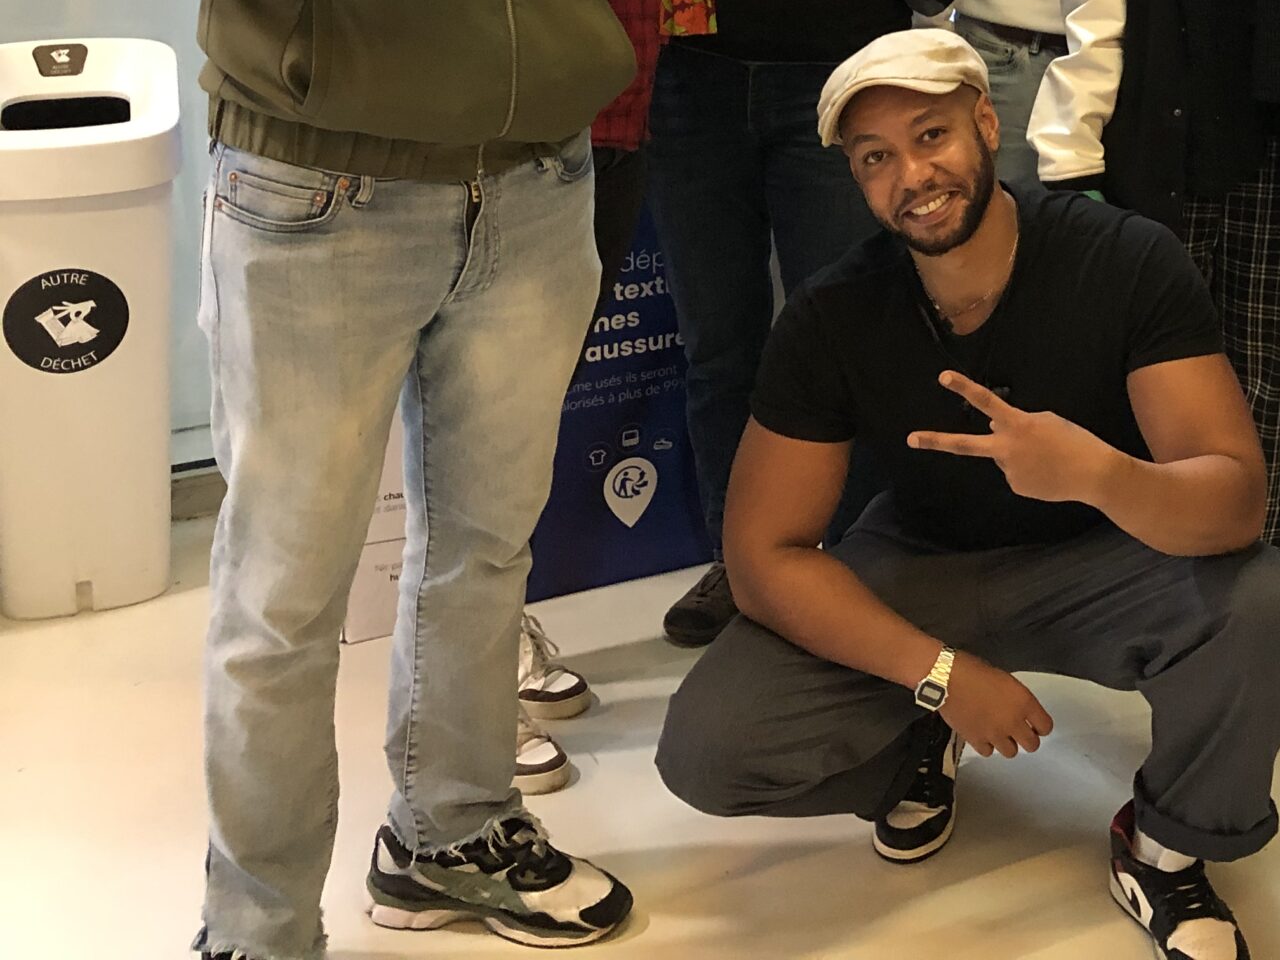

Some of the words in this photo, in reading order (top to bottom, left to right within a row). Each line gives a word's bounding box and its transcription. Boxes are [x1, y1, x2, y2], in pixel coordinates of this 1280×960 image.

[41, 273, 88, 290] AUTRE
[585, 331, 685, 363] aussur
[40, 350, 98, 370] DÉCHET
[572, 381, 592, 393] me
[595, 372, 622, 389] usés
[626, 370, 637, 384] ils
[640, 365, 677, 381] seront
[618, 387, 642, 403] plus
[645, 384, 660, 397] de
